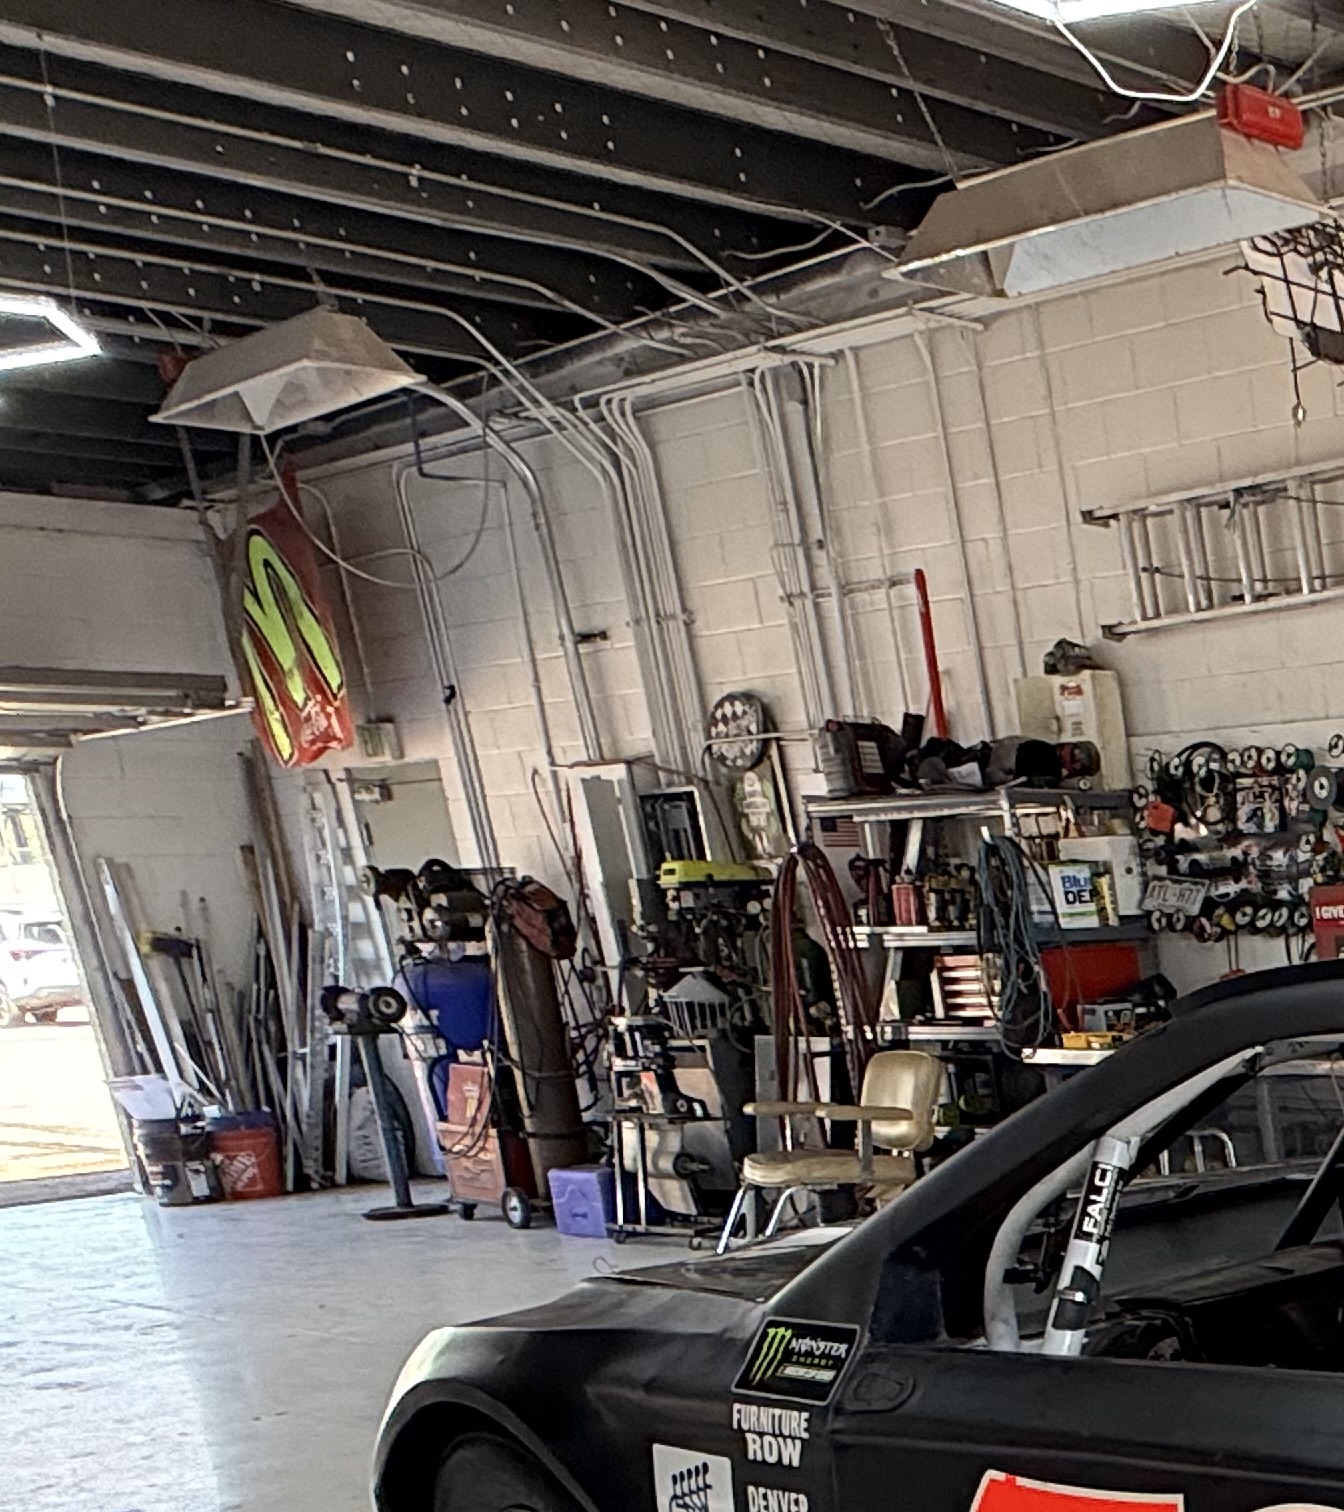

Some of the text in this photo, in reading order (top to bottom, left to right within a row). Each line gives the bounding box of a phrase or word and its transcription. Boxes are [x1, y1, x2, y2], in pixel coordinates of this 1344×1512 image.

[1060, 874, 1092, 890] Blu
[1082, 1163, 1114, 1234] FALCI
[732, 1403, 810, 1439] FURNITURE
[745, 1432, 802, 1467] ROW
